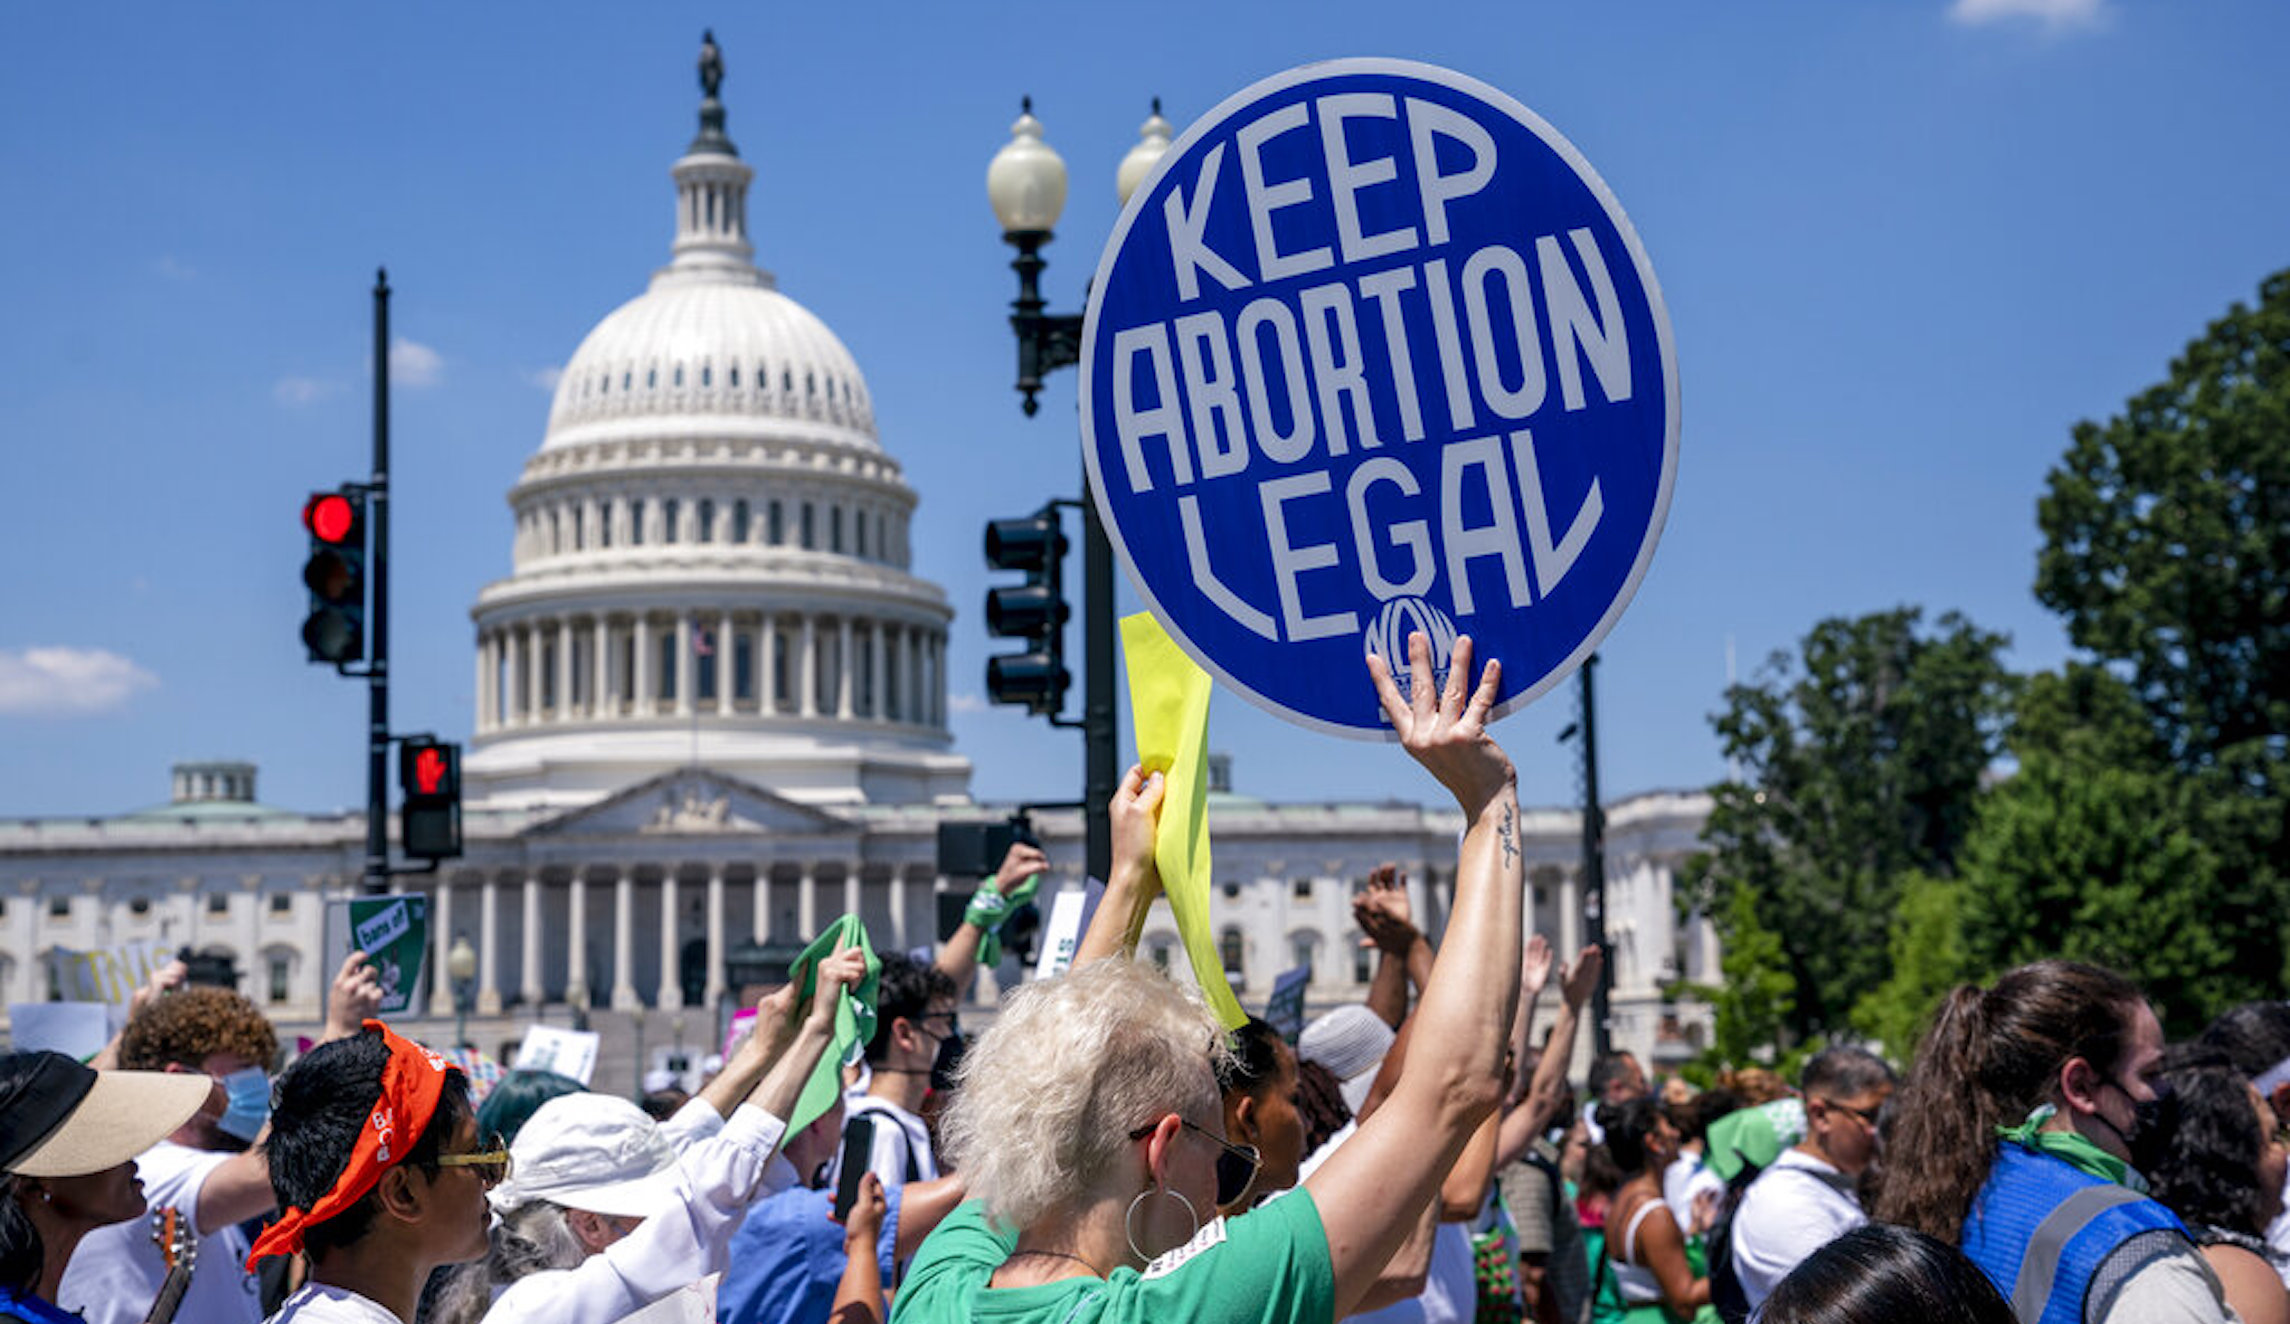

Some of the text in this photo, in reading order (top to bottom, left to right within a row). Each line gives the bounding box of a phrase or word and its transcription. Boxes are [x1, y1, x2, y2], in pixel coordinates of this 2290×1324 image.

[1164, 92, 1497, 302] KEEP
[1113, 227, 1632, 493] ABORTION
[1178, 429, 1603, 643] LEGAL
[361, 921, 391, 947] bans
